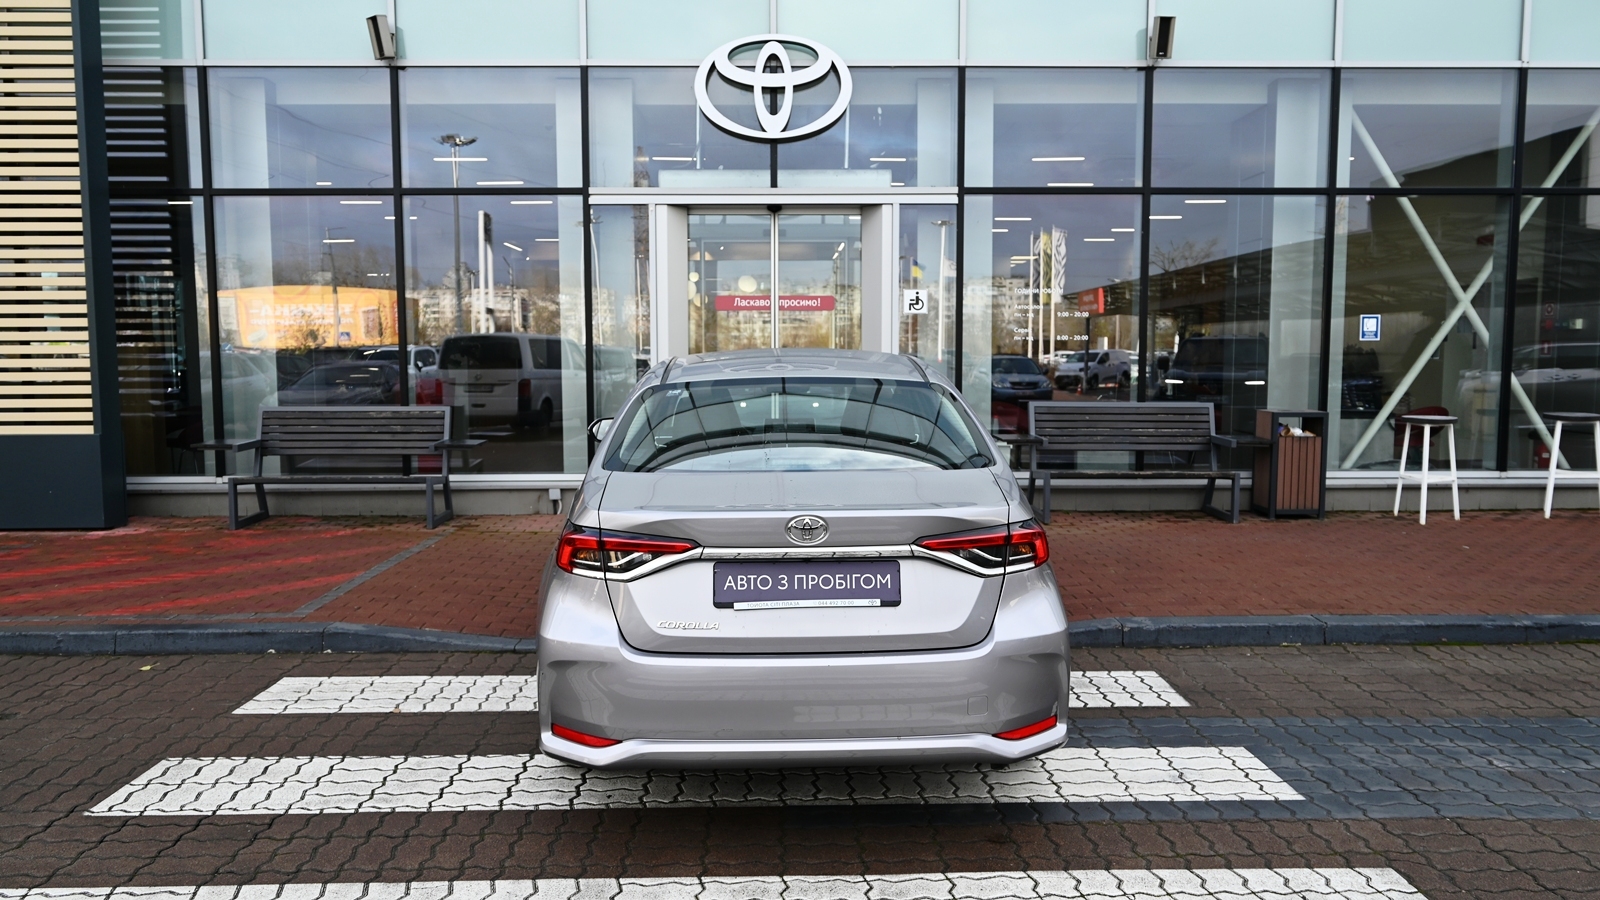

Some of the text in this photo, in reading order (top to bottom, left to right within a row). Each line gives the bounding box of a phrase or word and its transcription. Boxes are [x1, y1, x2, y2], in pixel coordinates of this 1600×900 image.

[733, 297, 821, 309] Ласкаво просимо!
[723, 573, 892, 591] АВТО З ПРОБІГОМ
[656, 620, 720, 631] COROLLA
